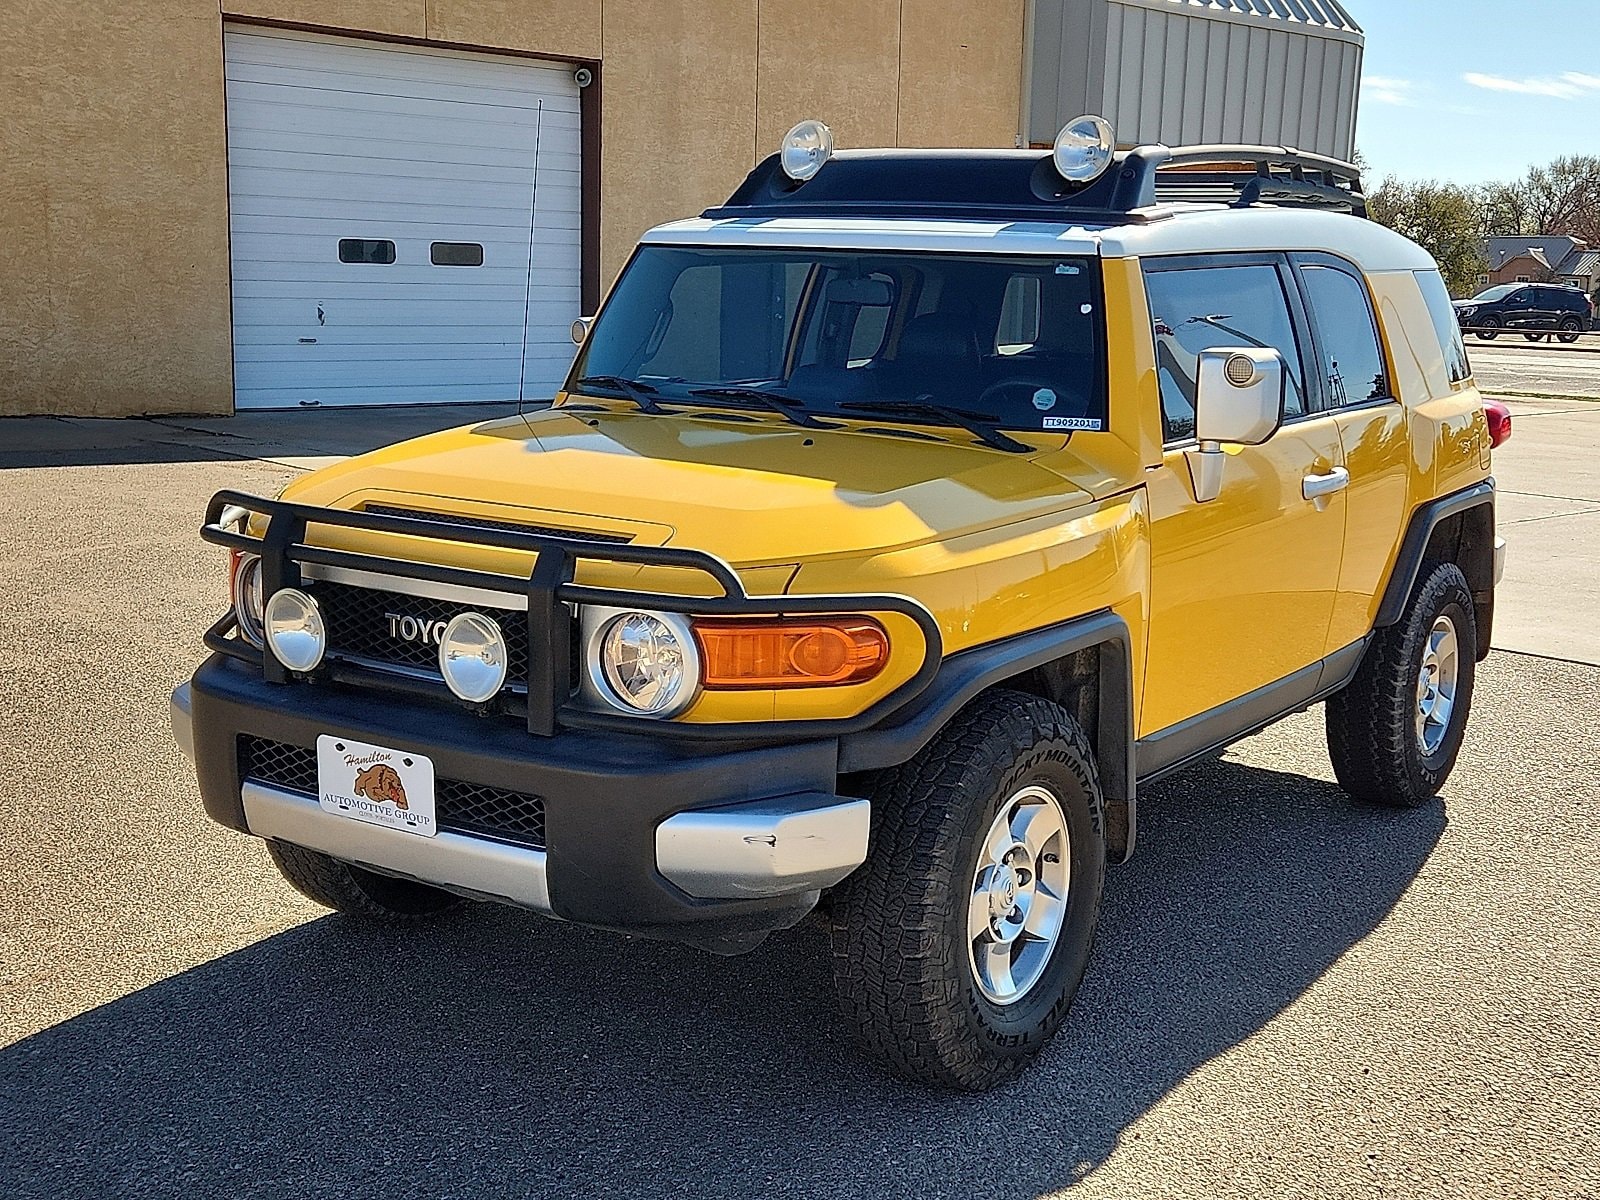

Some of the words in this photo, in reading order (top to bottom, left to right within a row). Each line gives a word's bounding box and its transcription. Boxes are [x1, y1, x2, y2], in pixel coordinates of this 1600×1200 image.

[343, 751, 392, 767] Hamilton
[1044, 749, 1101, 834] MOUNTAIN
[323, 793, 392, 816] AUTOMOTIVE
[394, 809, 430, 825] GROUP
